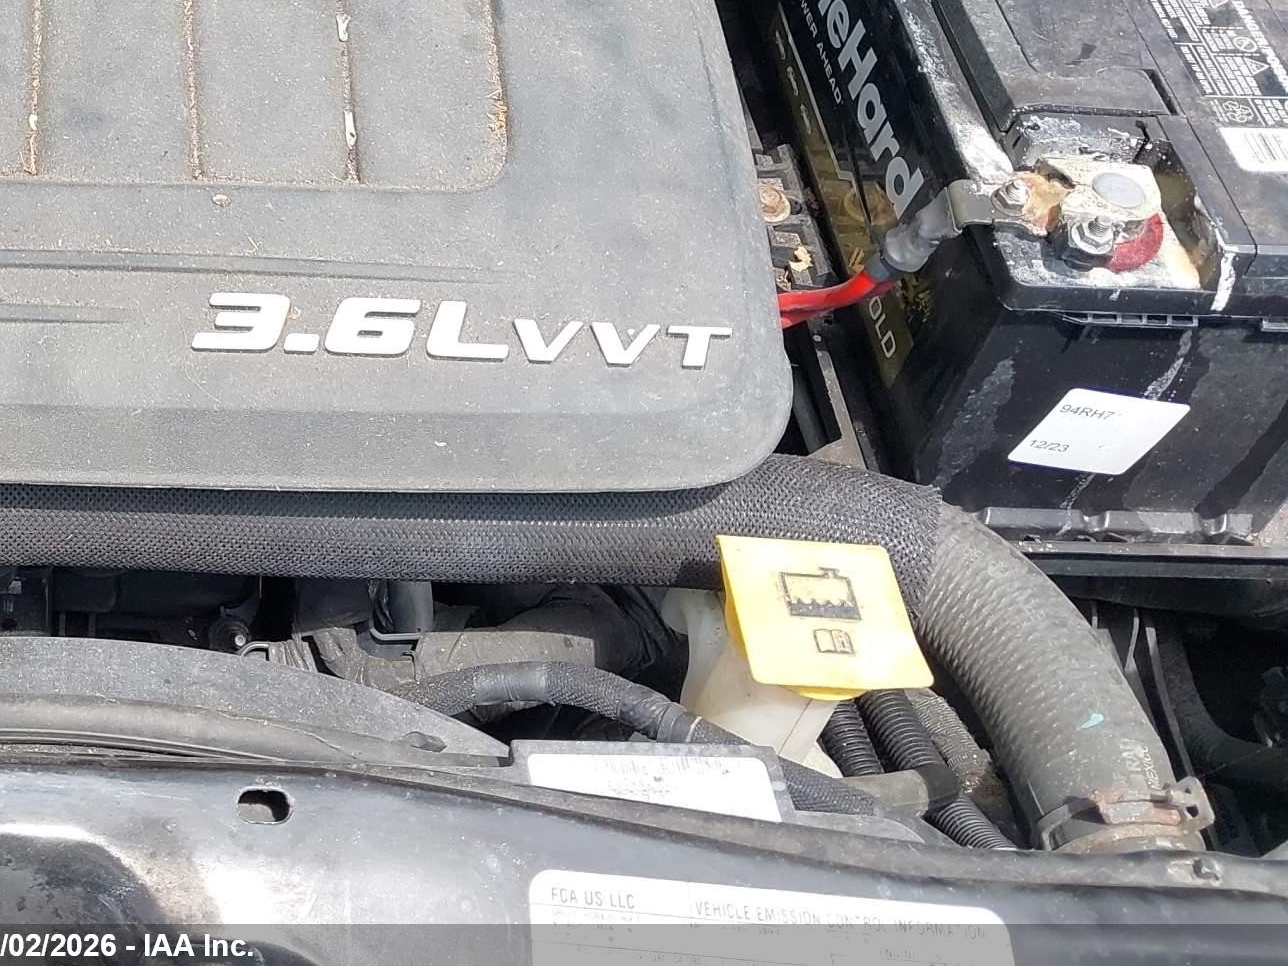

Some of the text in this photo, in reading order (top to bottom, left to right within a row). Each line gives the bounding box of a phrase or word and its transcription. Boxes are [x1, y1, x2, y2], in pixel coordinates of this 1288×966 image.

[815, 37, 843, 106] AHEAD
[868, 296, 898, 360] OLD
[1059, 404, 1116, 421] 94RH7
[1029, 439, 1069, 452] 12/23
[551, 887, 635, 910] FCA US LLC
[695, 900, 751, 921] VEHICLE
[757, 905, 822, 927] EMISSION
